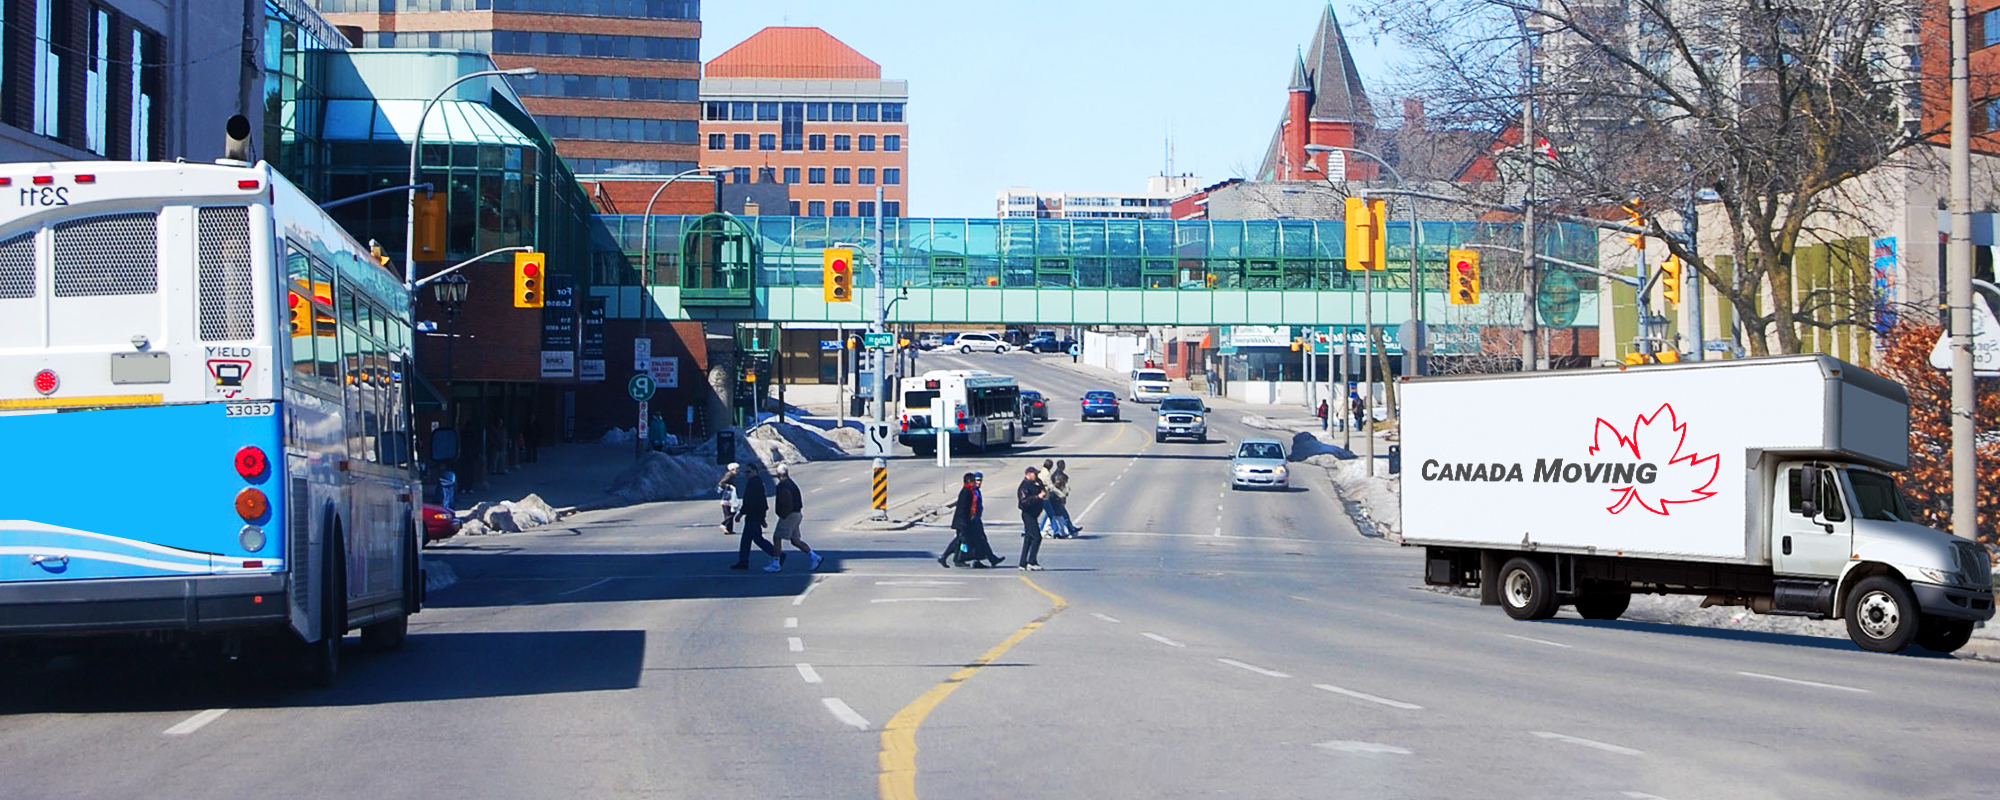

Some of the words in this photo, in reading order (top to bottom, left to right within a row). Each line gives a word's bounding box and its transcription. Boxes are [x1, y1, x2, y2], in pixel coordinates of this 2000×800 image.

[206, 346, 251, 357] YIELD
[1421, 458, 1524, 482] CANADA
[1532, 458, 1658, 484] MOVING
